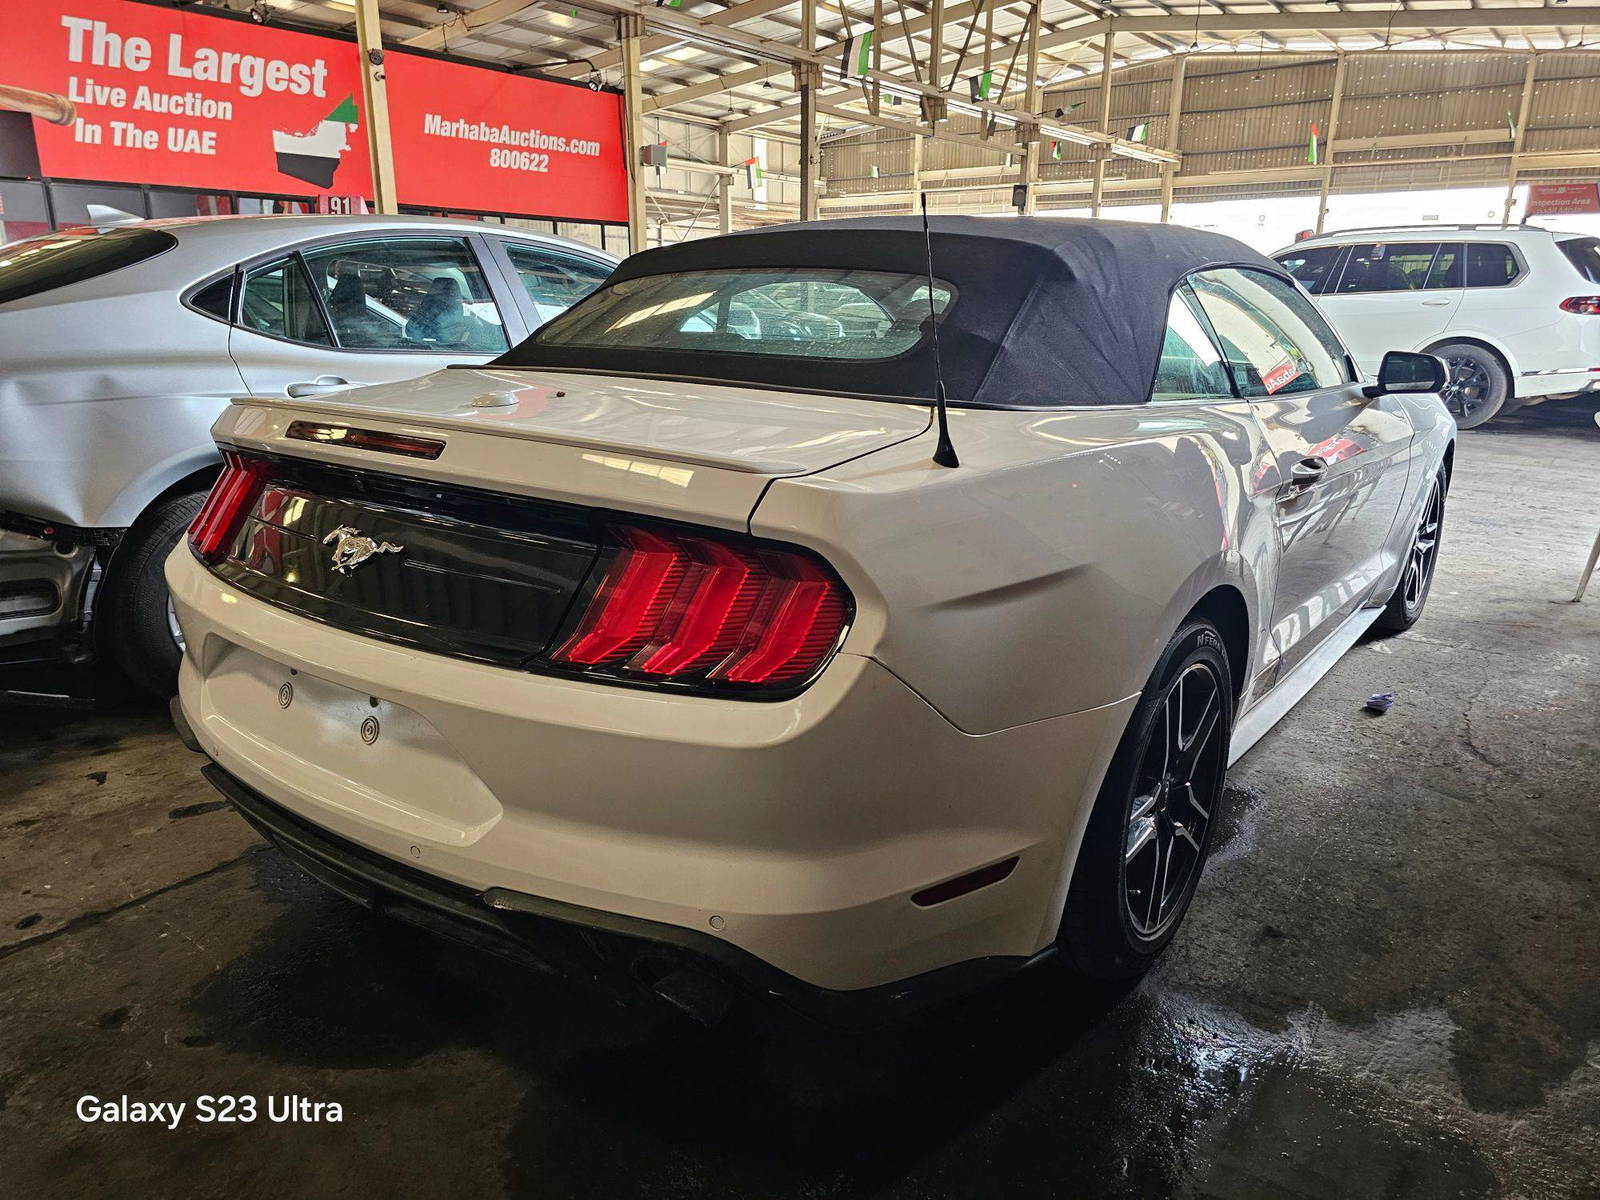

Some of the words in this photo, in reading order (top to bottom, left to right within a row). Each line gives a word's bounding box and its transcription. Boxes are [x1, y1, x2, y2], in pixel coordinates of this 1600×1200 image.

[61, 15, 151, 72] The
[168, 33, 327, 98] Largest
[68, 77, 127, 107] Live
[133, 85, 233, 120] Auction
[74, 118, 102, 144] In
[110, 120, 159, 149] The
[167, 128, 217, 155] UAE
[424, 113, 600, 156] MarhabaAuctions.com
[489, 148, 550, 172] 800622
[331, 197, 350, 214] 91
